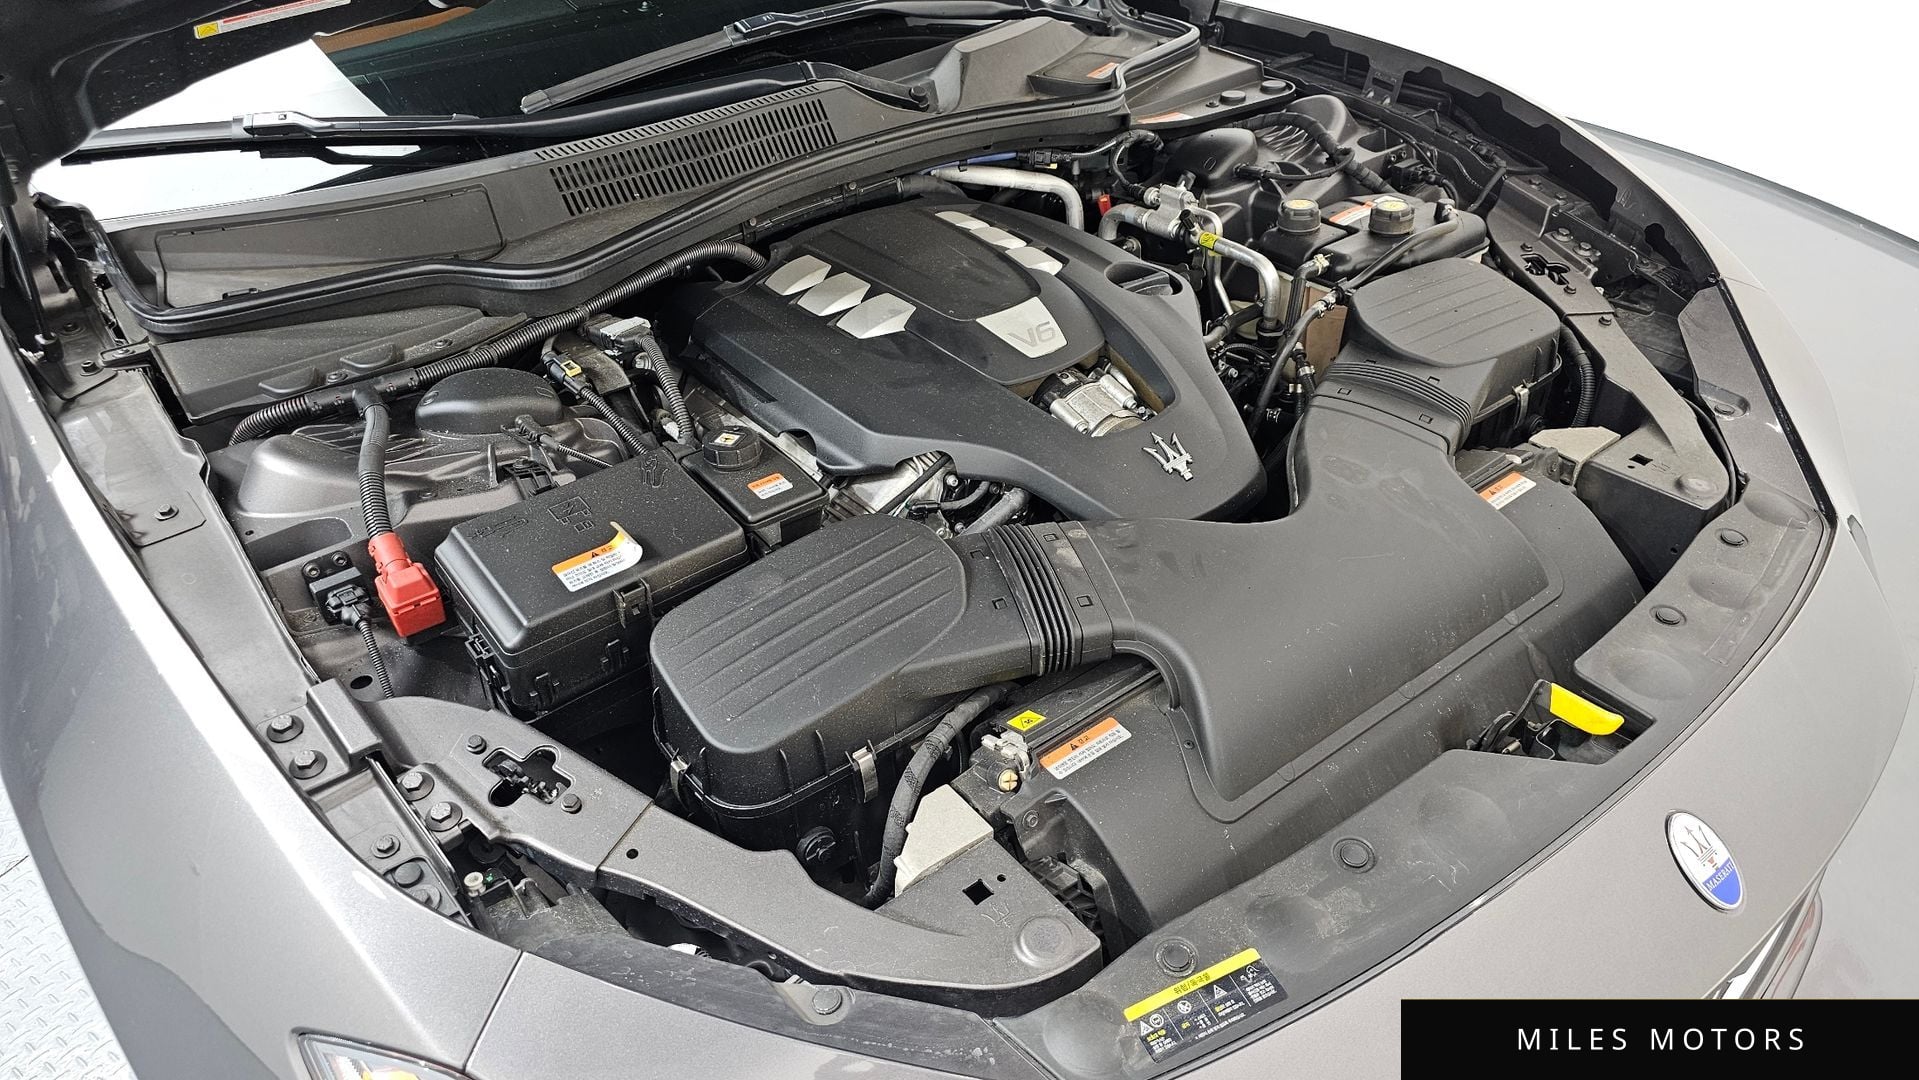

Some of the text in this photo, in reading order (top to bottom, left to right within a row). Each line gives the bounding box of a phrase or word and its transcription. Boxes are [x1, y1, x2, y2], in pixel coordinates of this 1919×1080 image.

[1008, 321, 1056, 347] V6
[1706, 862, 1735, 892] MASERATI
[1173, 972, 1212, 995] 위험/독극물
